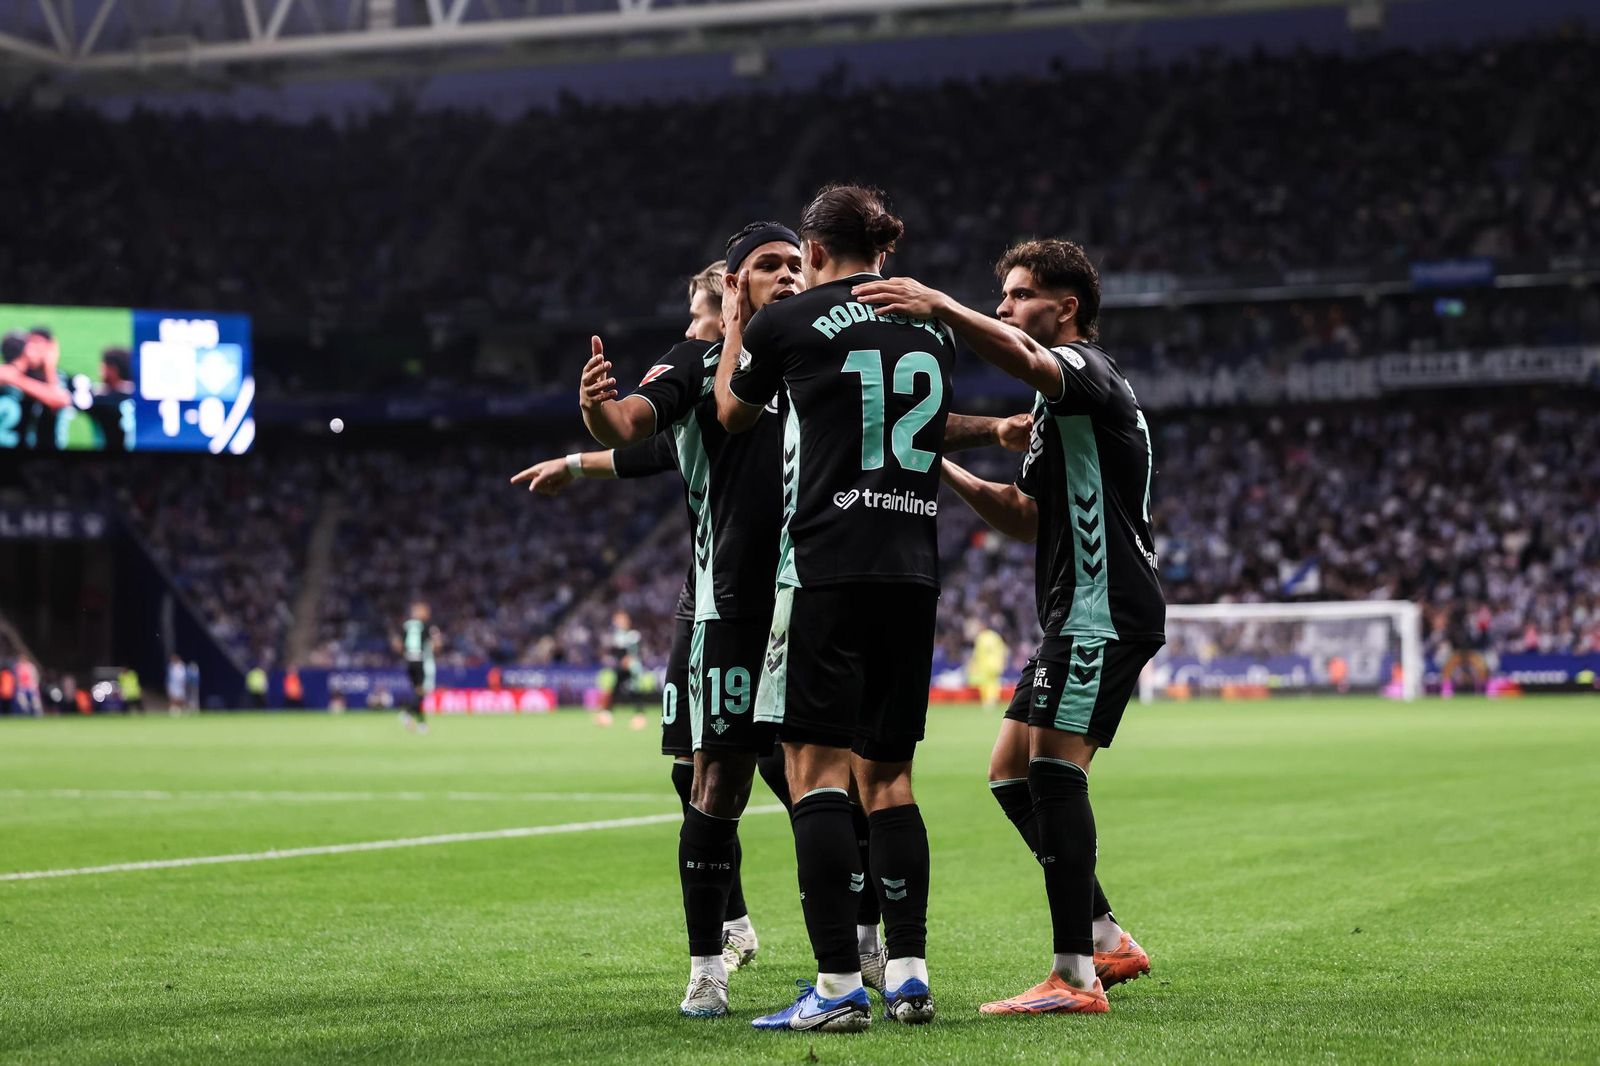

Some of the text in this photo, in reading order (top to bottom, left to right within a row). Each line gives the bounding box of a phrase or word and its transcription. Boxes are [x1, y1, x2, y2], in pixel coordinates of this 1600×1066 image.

[841, 350, 943, 473] 12
[862, 487, 938, 517] trainline
[706, 666, 751, 716] 19
[686, 860, 731, 870] BETIS
